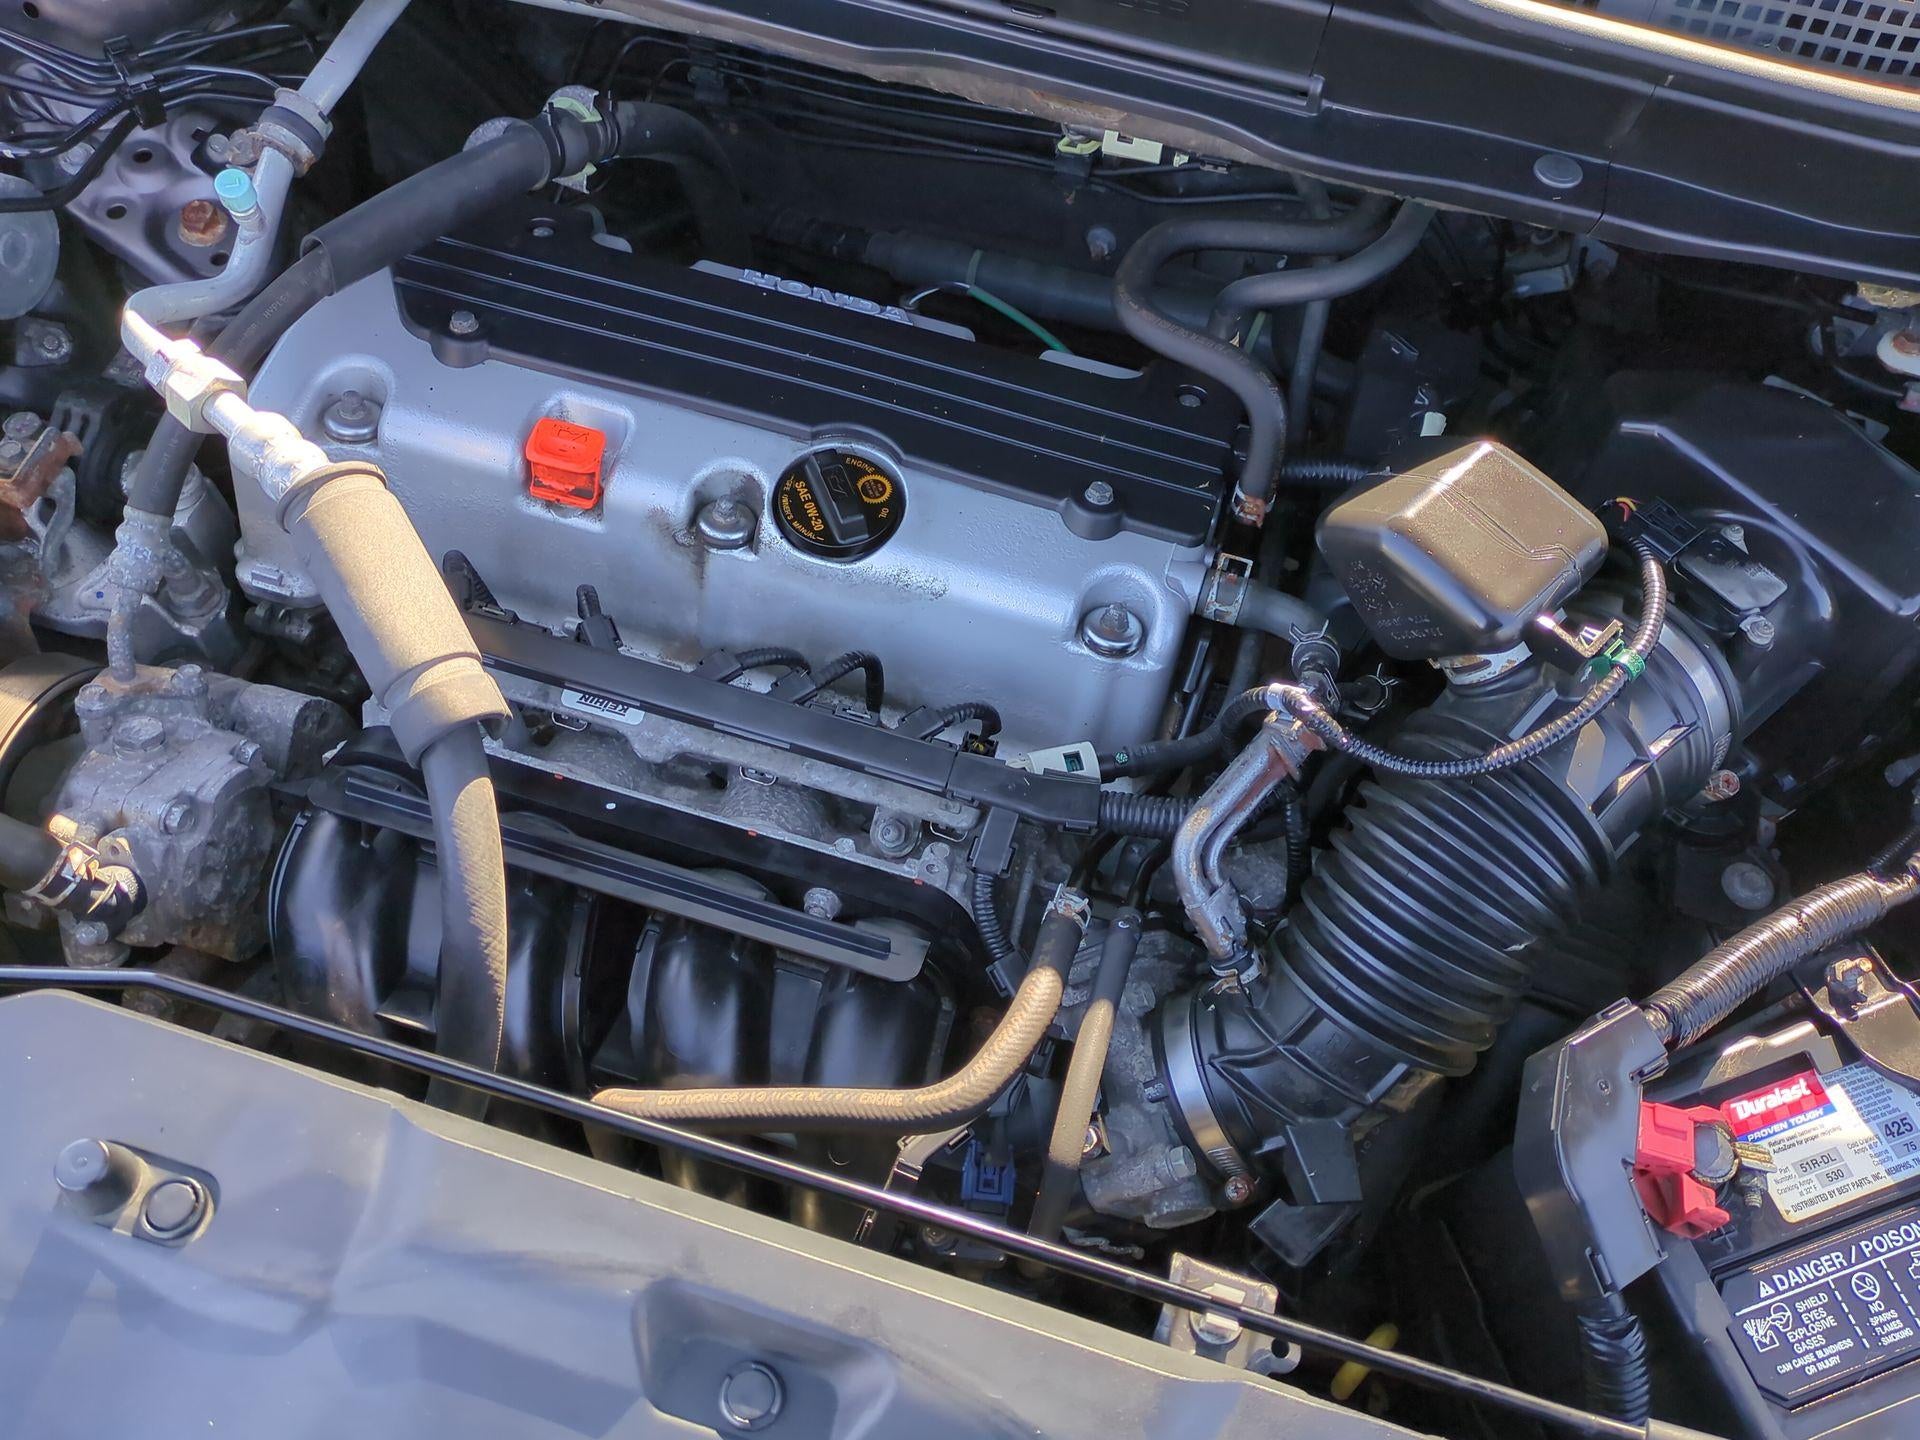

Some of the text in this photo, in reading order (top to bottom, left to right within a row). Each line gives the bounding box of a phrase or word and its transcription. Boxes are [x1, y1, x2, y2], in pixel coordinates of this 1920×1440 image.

[738, 268, 914, 326] HONDA
[845, 457, 876, 473] ENGINE
[795, 480, 825, 531] SAE 0W-20
[878, 507, 890, 519] OIL
[792, 520, 816, 540] MANUAL
[1730, 1078, 1812, 1120] Duralast
[1747, 1108, 1825, 1142] PROVEN TOUGH
[1884, 1117, 1914, 1138] 425
[1772, 1142, 1796, 1154] AutoZone
[1795, 1138, 1804, 1146] for
[1903, 1141, 1918, 1153] 75
[1799, 1153, 1837, 1173] 51R-DL
[1825, 1168, 1845, 1182] 530
[1791, 1193, 1829, 1213] DISTRIBUTED
[1827, 1189, 1837, 1199] BY
[1836, 1183, 1853, 1196] BEST
[1852, 1176, 1873, 1190] PARTS,
[1885, 1160, 1915, 1177] MEMPHIS,
[1772, 1251, 1848, 1291] DANGER
[1858, 1220, 1920, 1258] POISON
[1795, 1293, 1829, 1313] SHIELD
[1868, 1300, 1885, 1313] NO
[1801, 1307, 1827, 1324] EYES
[1869, 1309, 1898, 1326] SPARKS
[1786, 1315, 1838, 1342] EXPLOSIVE
[1875, 1319, 1904, 1335] FLAMES
[1880, 1327, 1914, 1346] SMOKING
[1793, 1335, 1826, 1353] GASES
[1776, 1338, 1854, 1374] CAN CAUSE BLINDNESS
[1804, 1355, 1841, 1375] OR INJURY
